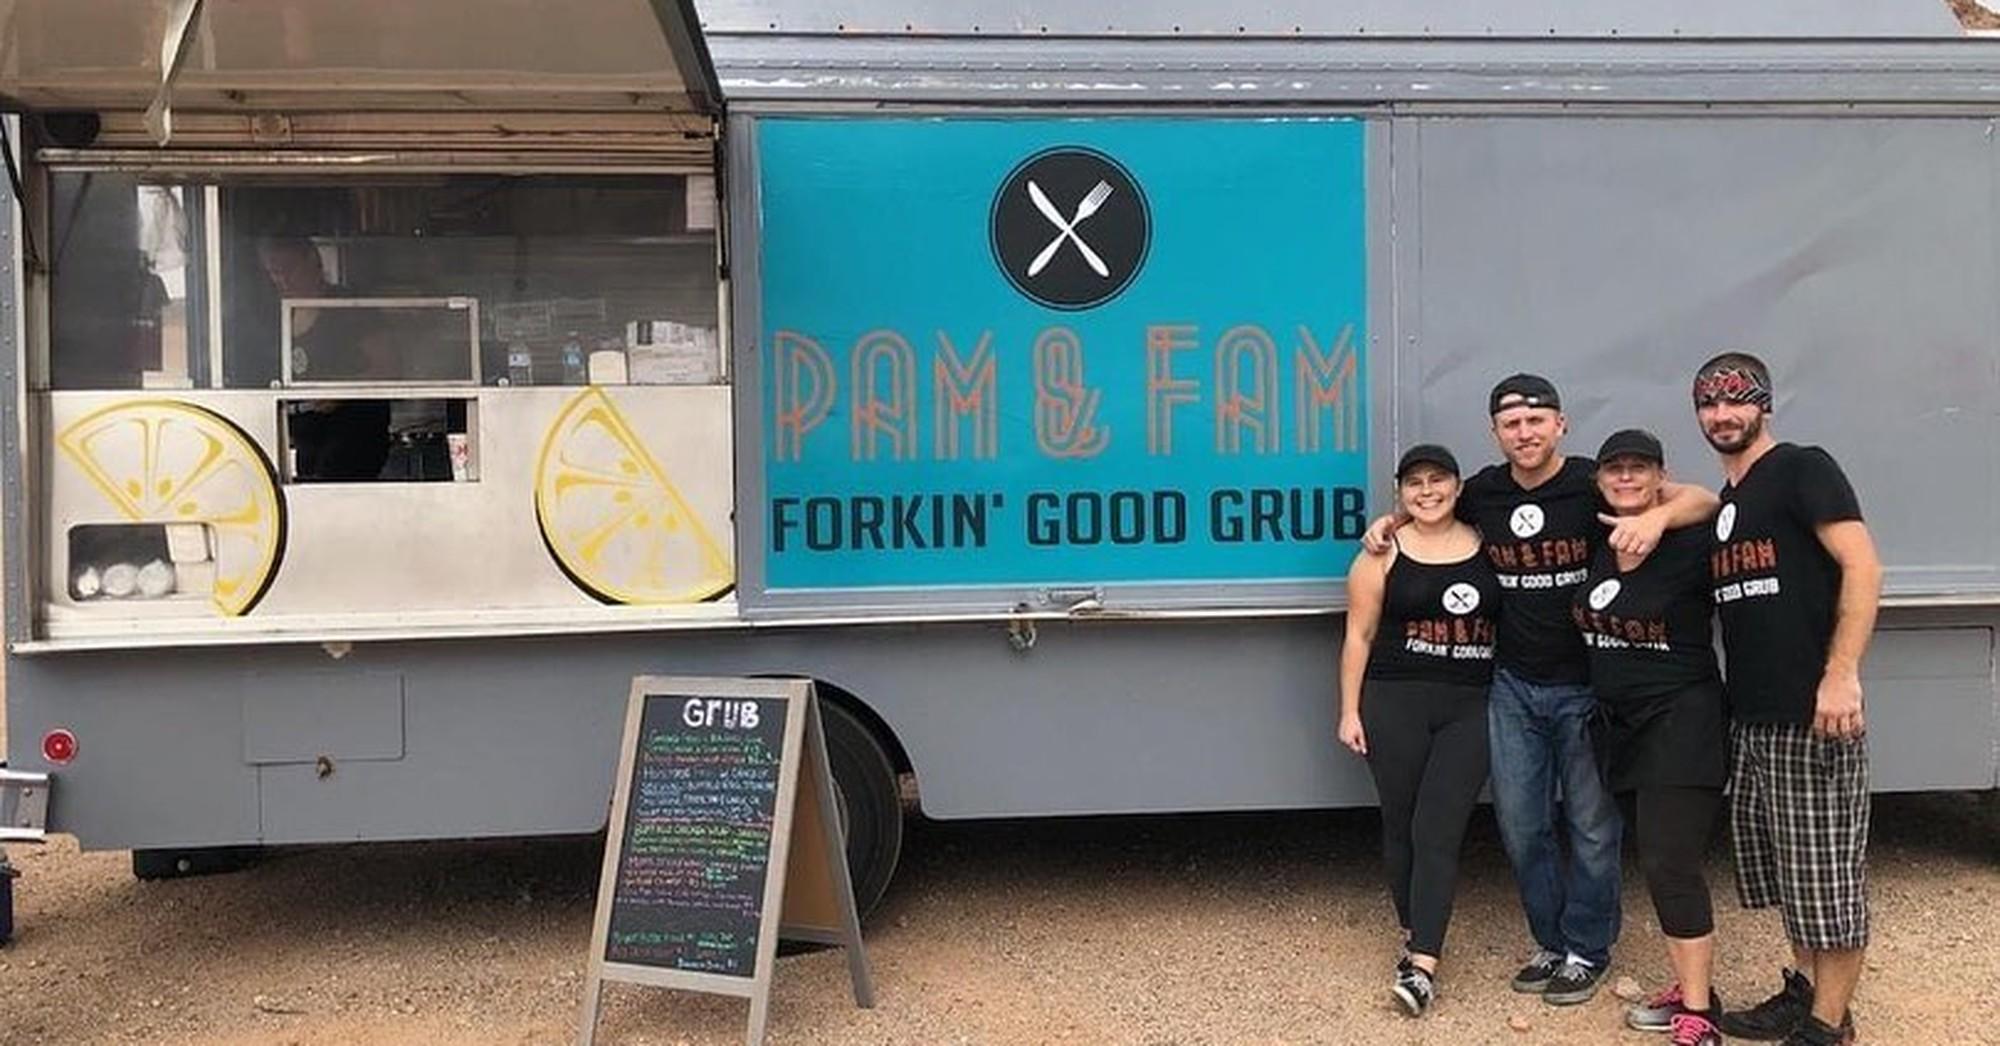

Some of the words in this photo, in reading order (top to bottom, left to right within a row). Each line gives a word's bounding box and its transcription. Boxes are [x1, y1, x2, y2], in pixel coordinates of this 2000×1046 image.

[772, 328, 997, 462] PAM
[1032, 327, 1111, 459] &
[1145, 323, 1360, 457] FAM
[772, 493, 1004, 553] FORKIN'
[1026, 490, 1187, 547] GOOD
[1210, 487, 1368, 543] GRUB
[1732, 538, 1777, 573] FAM
